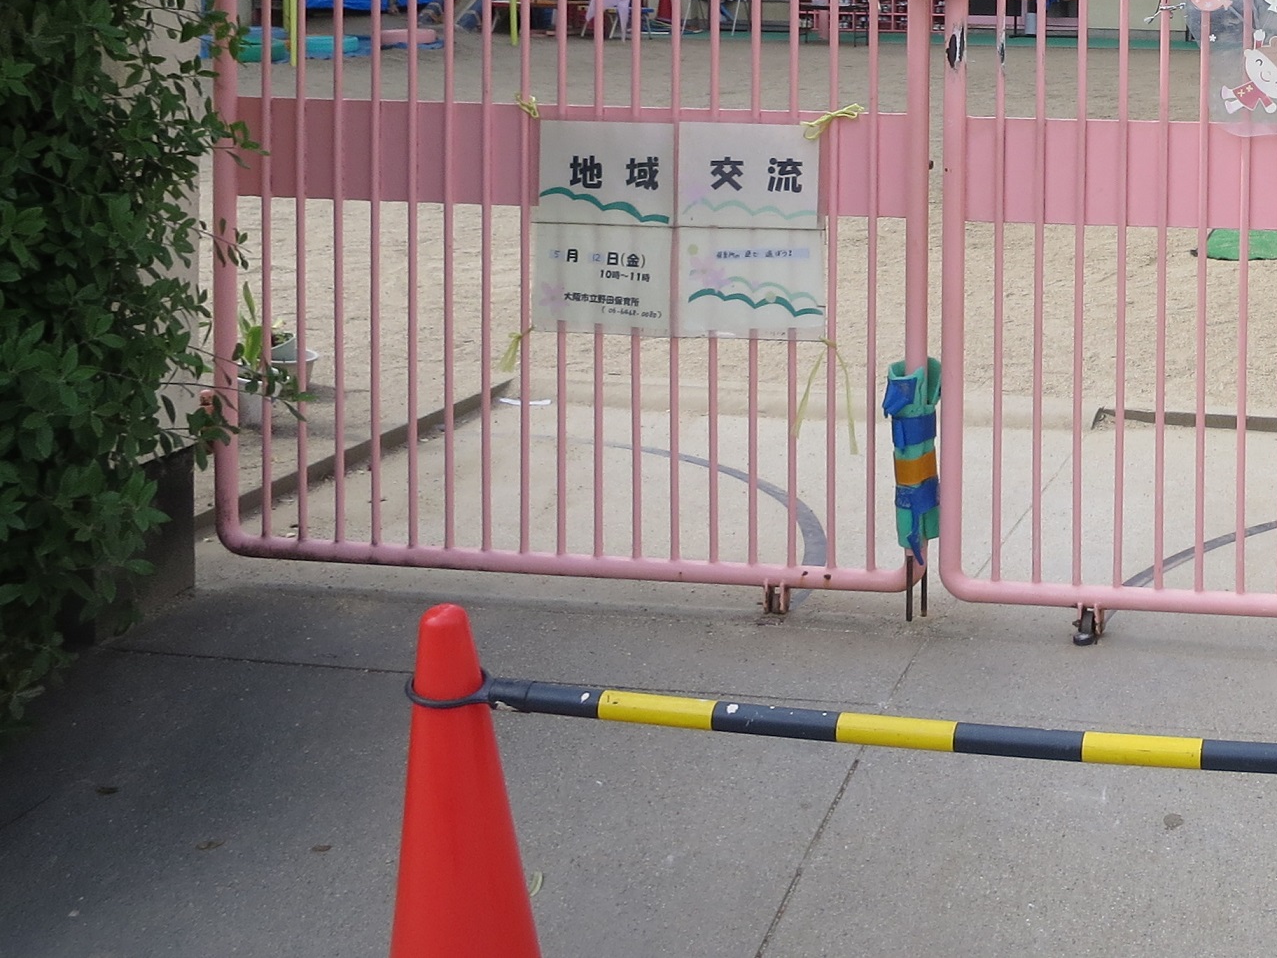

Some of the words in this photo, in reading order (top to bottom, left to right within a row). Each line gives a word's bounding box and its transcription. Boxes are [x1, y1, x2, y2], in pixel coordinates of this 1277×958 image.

[569, 155, 660, 190] 地域
[710, 156, 803, 193] 交流
[564, 292, 640, 307] 大阪市立野田保育所
